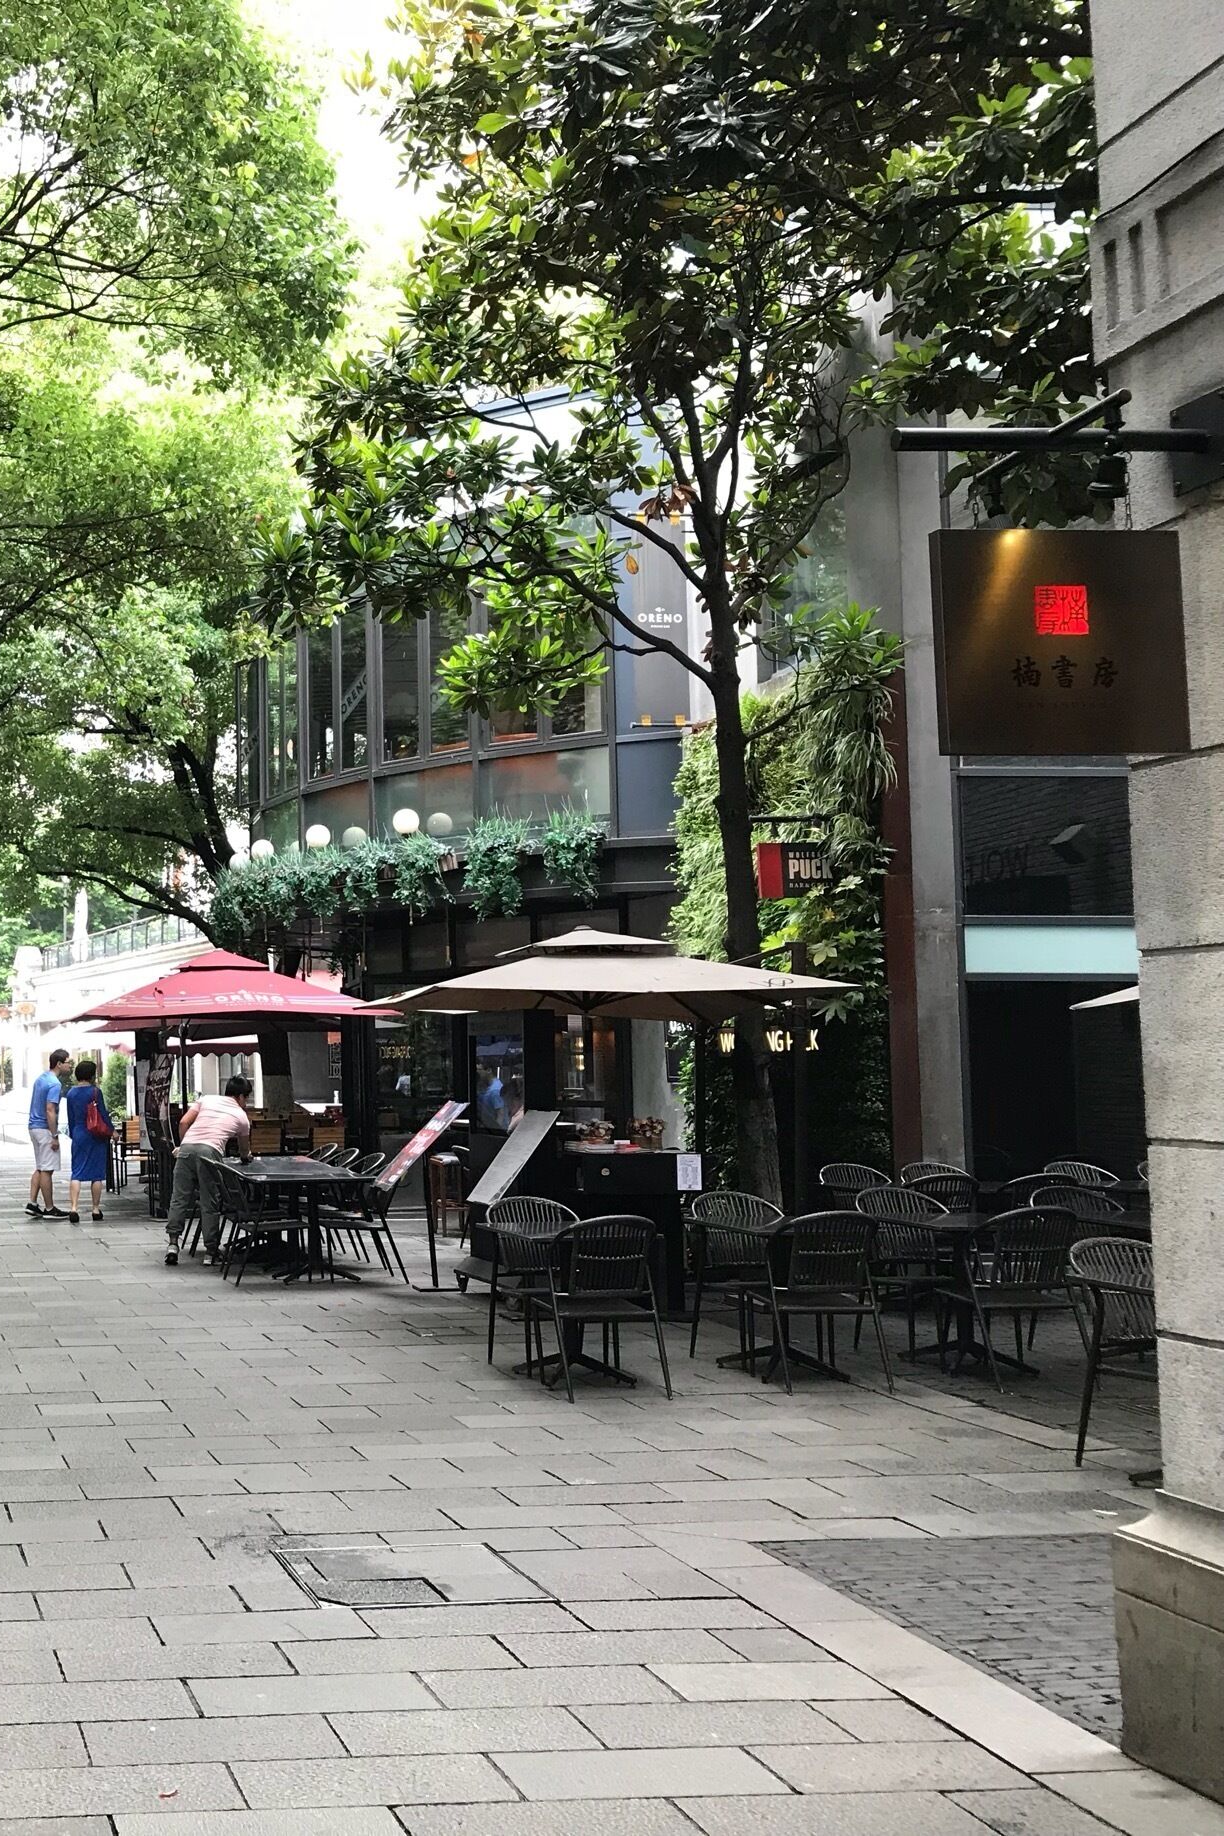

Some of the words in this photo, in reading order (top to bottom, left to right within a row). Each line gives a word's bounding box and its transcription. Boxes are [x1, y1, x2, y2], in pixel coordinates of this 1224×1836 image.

[637, 612, 683, 623] ORENO
[1010, 654, 1119, 689] 楠書房
[788, 859, 834, 880] PUCK
